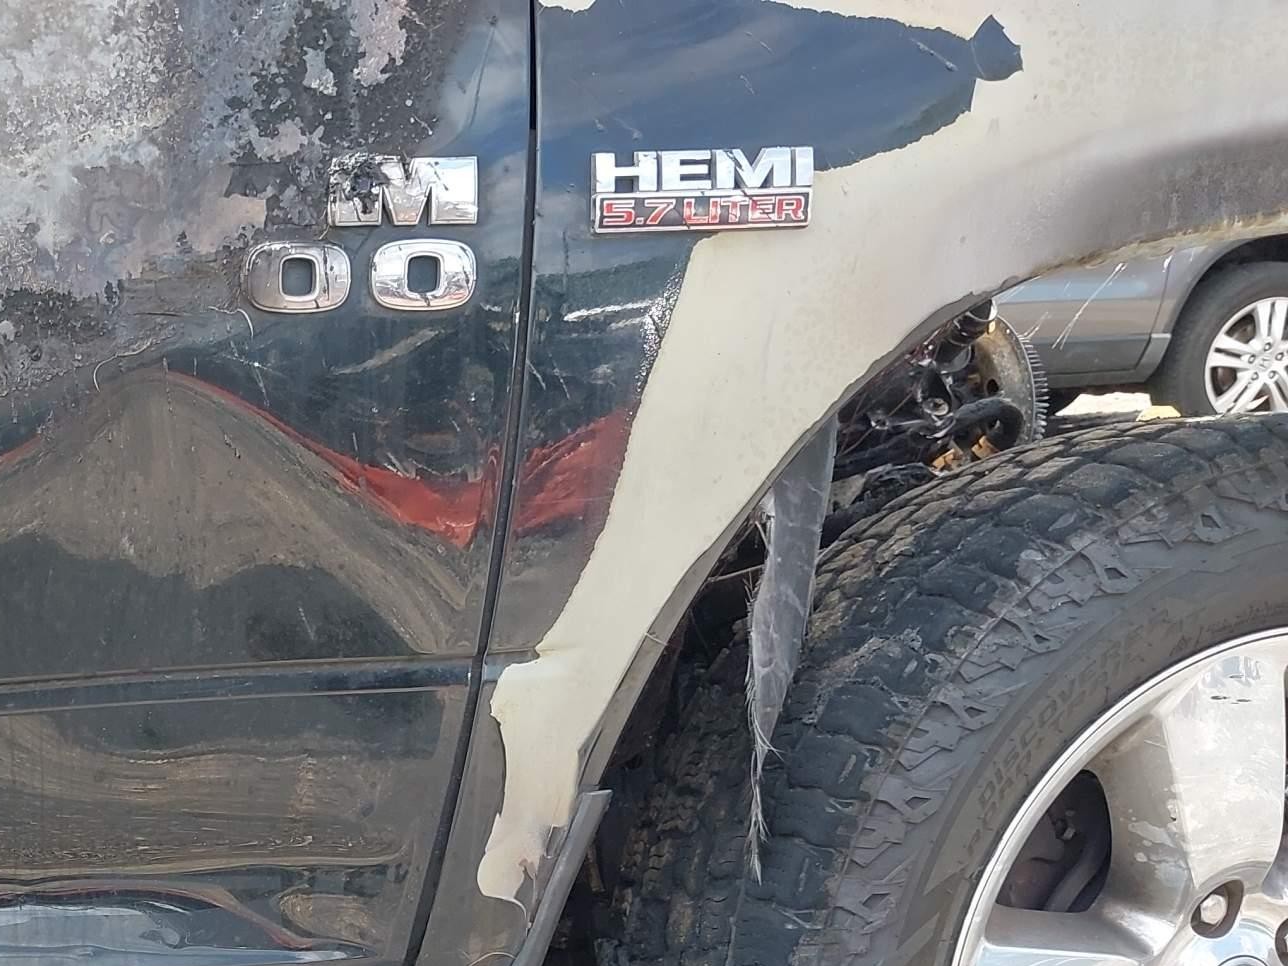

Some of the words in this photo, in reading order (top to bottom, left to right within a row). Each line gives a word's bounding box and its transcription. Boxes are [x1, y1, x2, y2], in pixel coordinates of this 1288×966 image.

[592, 146, 814, 193] HEMI
[602, 199, 677, 226] 5.7
[683, 195, 805, 225] LITER
